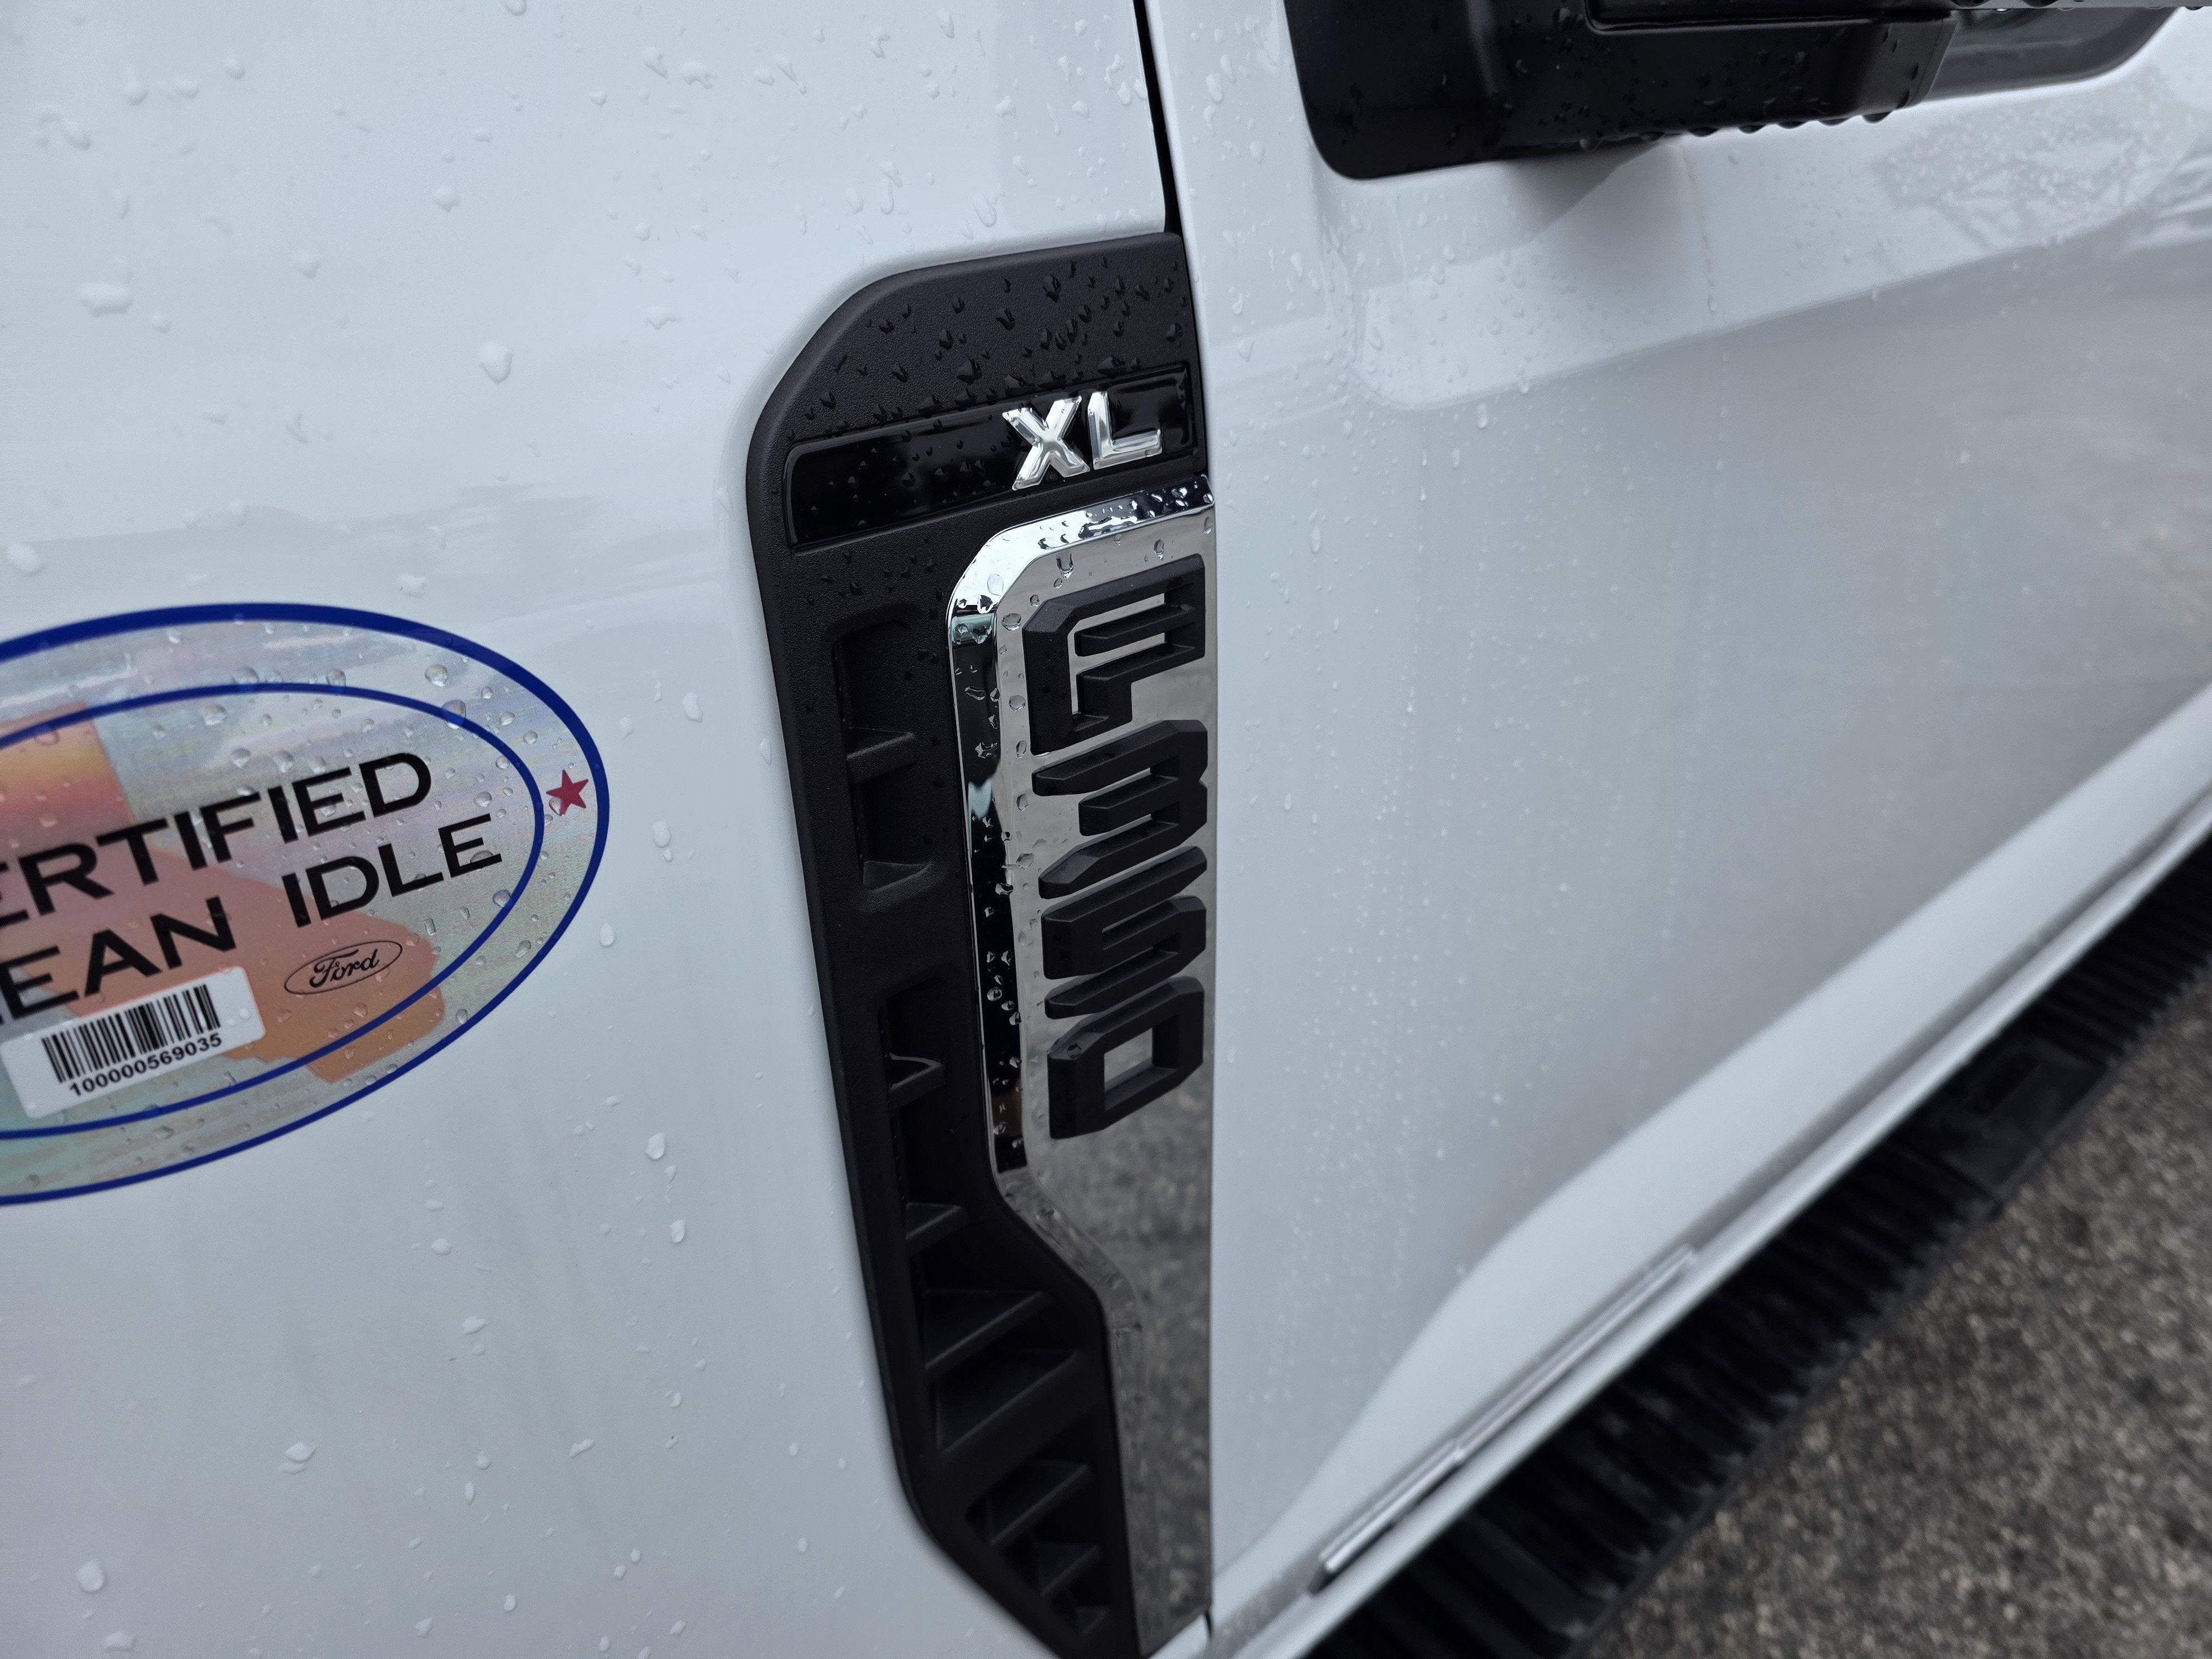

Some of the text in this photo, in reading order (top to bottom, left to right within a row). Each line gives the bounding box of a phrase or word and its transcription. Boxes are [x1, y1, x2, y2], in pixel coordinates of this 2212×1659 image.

[1002, 390, 1162, 491] XL
[1022, 553, 1208, 1140] F350
[0, 813, 502, 1023] EAN IDLE
[309, 948, 380, 988] Ford
[70, 1032, 222, 1096] 100000569035
